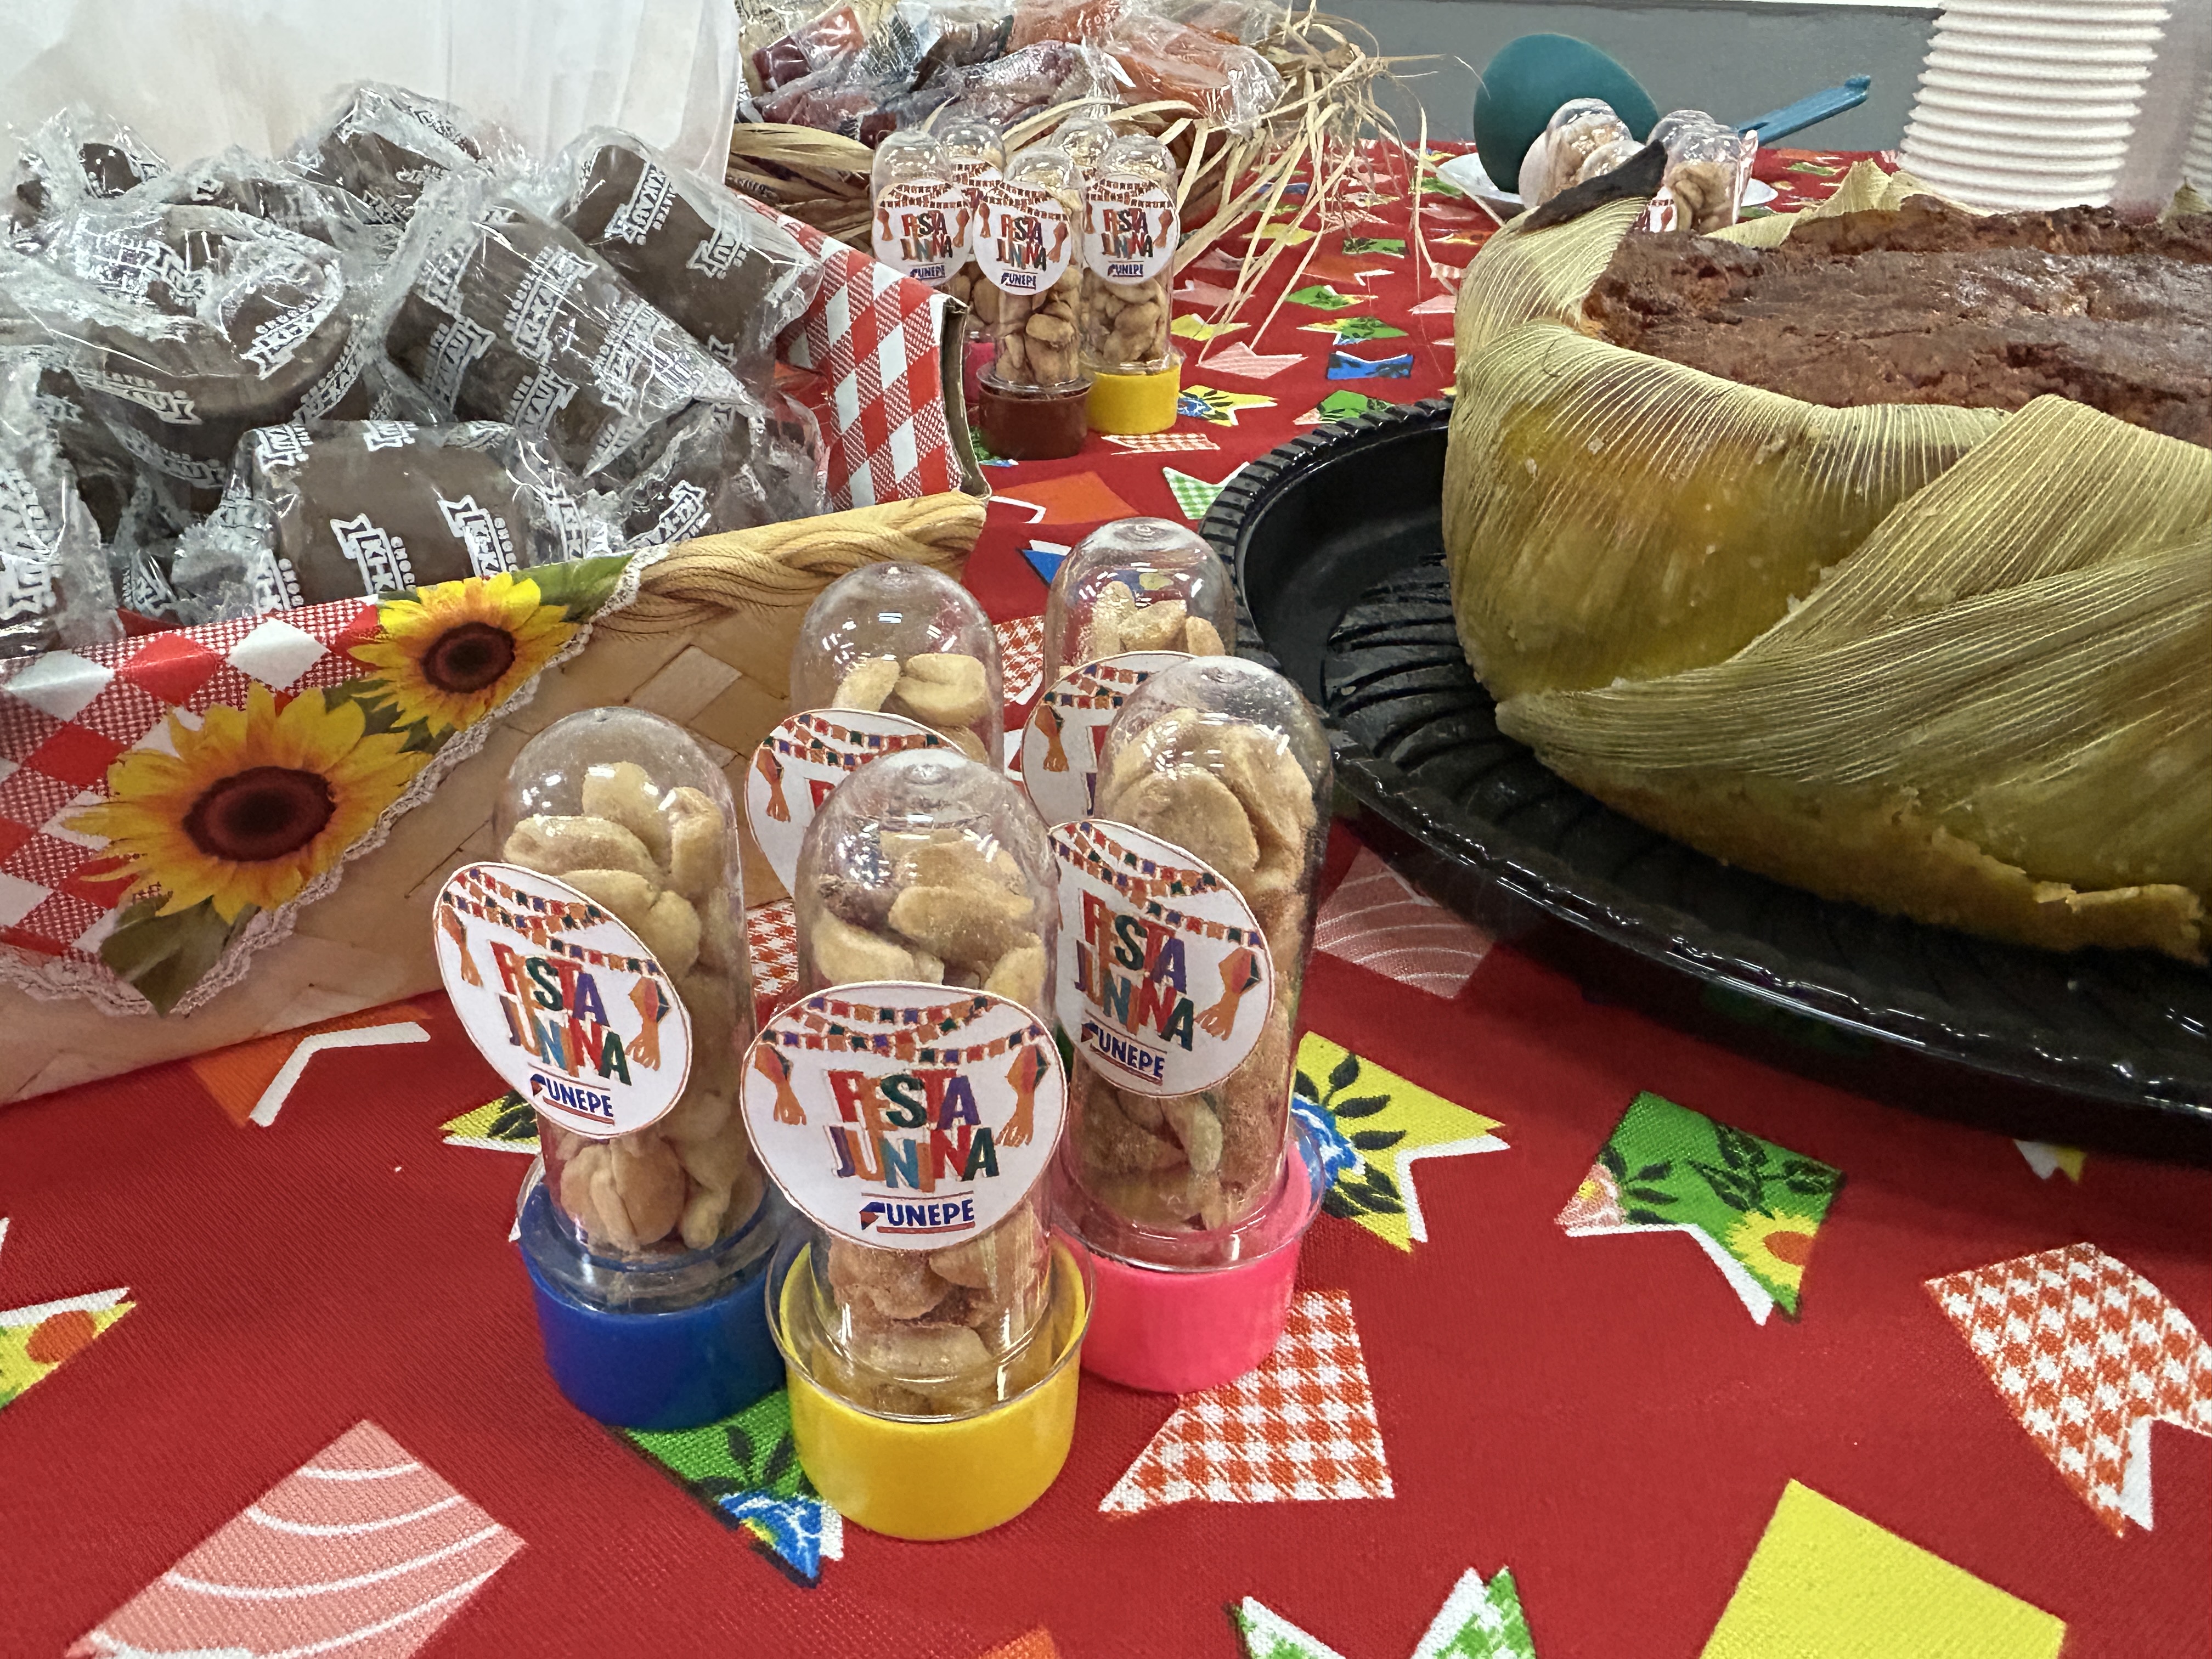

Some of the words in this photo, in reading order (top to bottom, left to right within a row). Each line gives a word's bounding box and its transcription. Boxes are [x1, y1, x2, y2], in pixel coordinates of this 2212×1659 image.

[490, 941, 611, 1028] FESTA
[1078, 888, 1187, 995] FESTA
[499, 992, 633, 1086] JUNINA
[1074, 939, 1195, 1052] JUNINA
[827, 1069, 981, 1130] FESTA
[823, 1124, 1000, 1193] JUNINA
